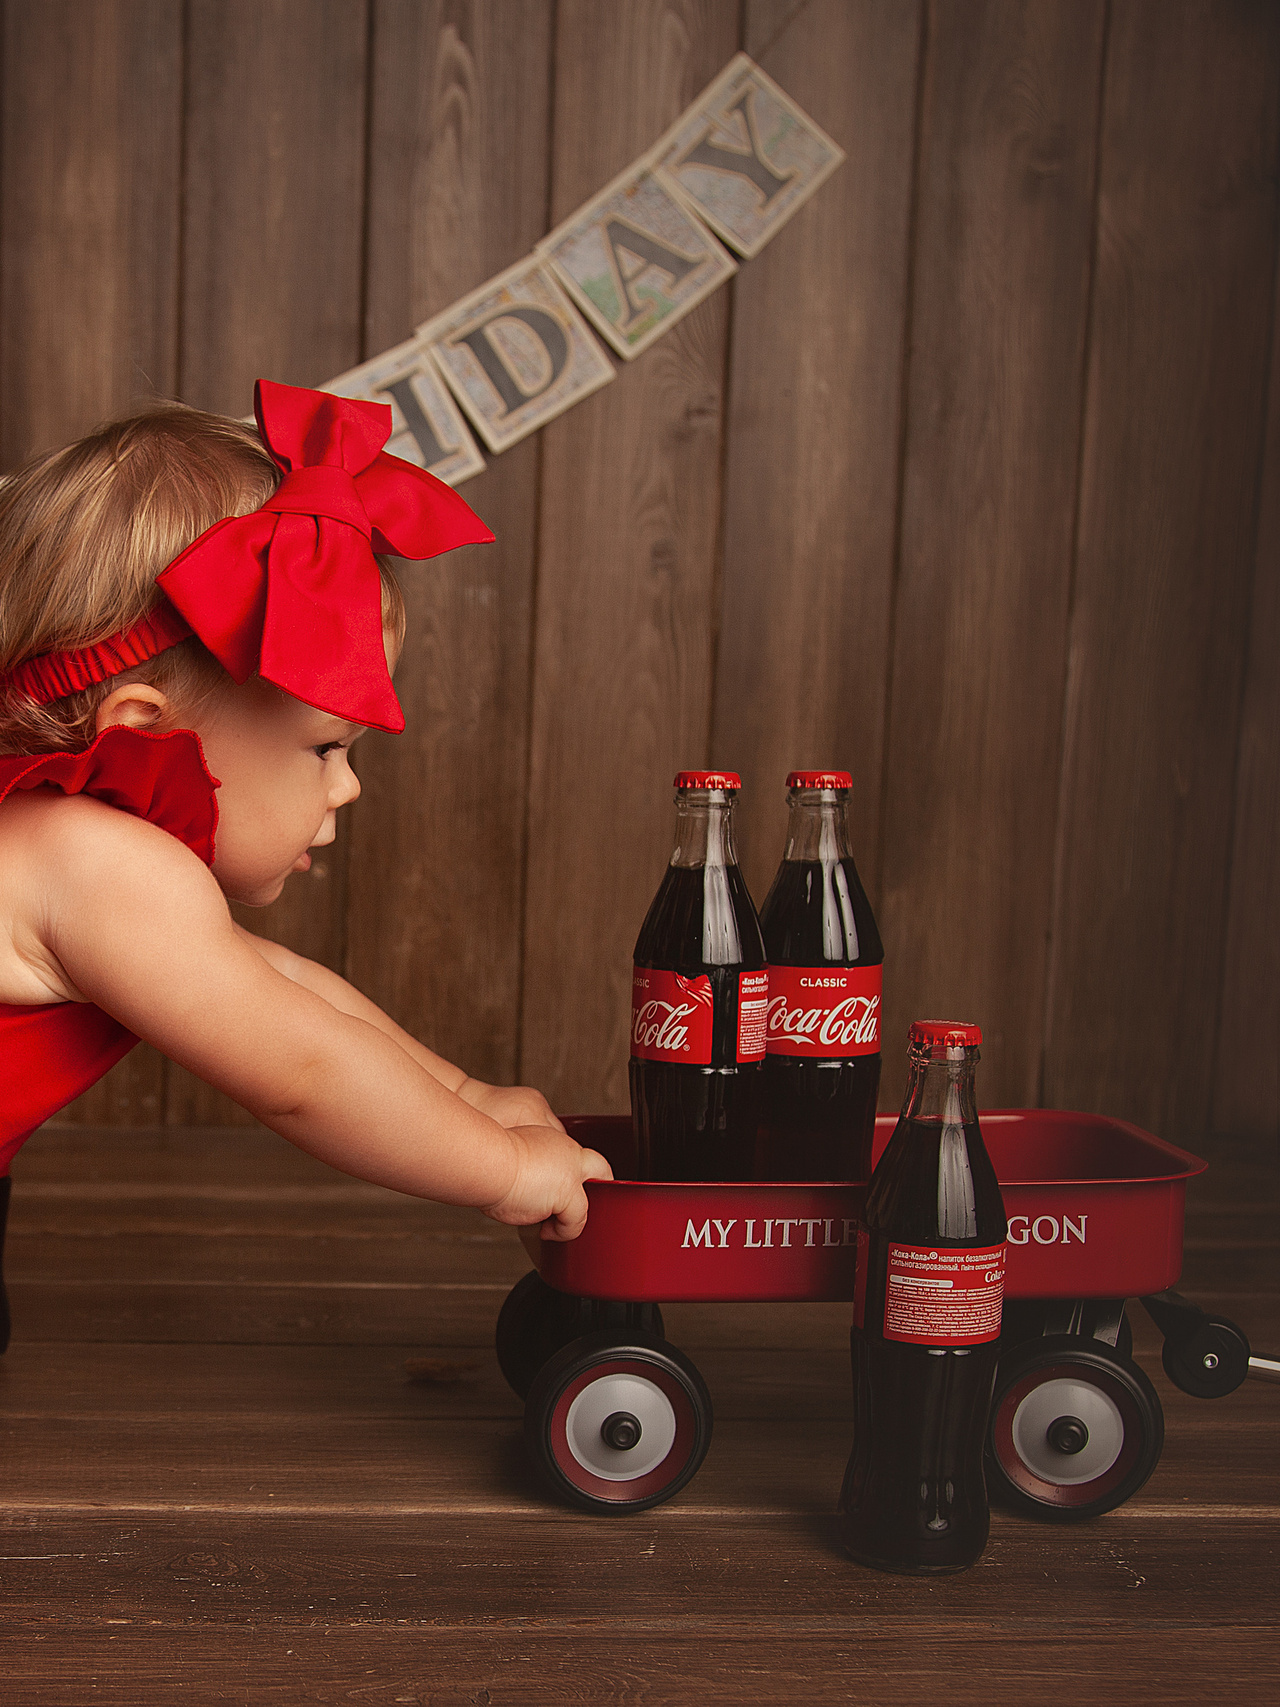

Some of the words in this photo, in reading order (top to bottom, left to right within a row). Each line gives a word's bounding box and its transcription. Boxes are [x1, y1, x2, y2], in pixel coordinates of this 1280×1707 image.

[799, 977, 848, 988] CLASSIC
[766, 995, 880, 1046] Coca-Cola
[681, 1218, 738, 1248] MY
[743, 1218, 858, 1248] LITTLE
[1006, 1214, 1089, 1246] GON
